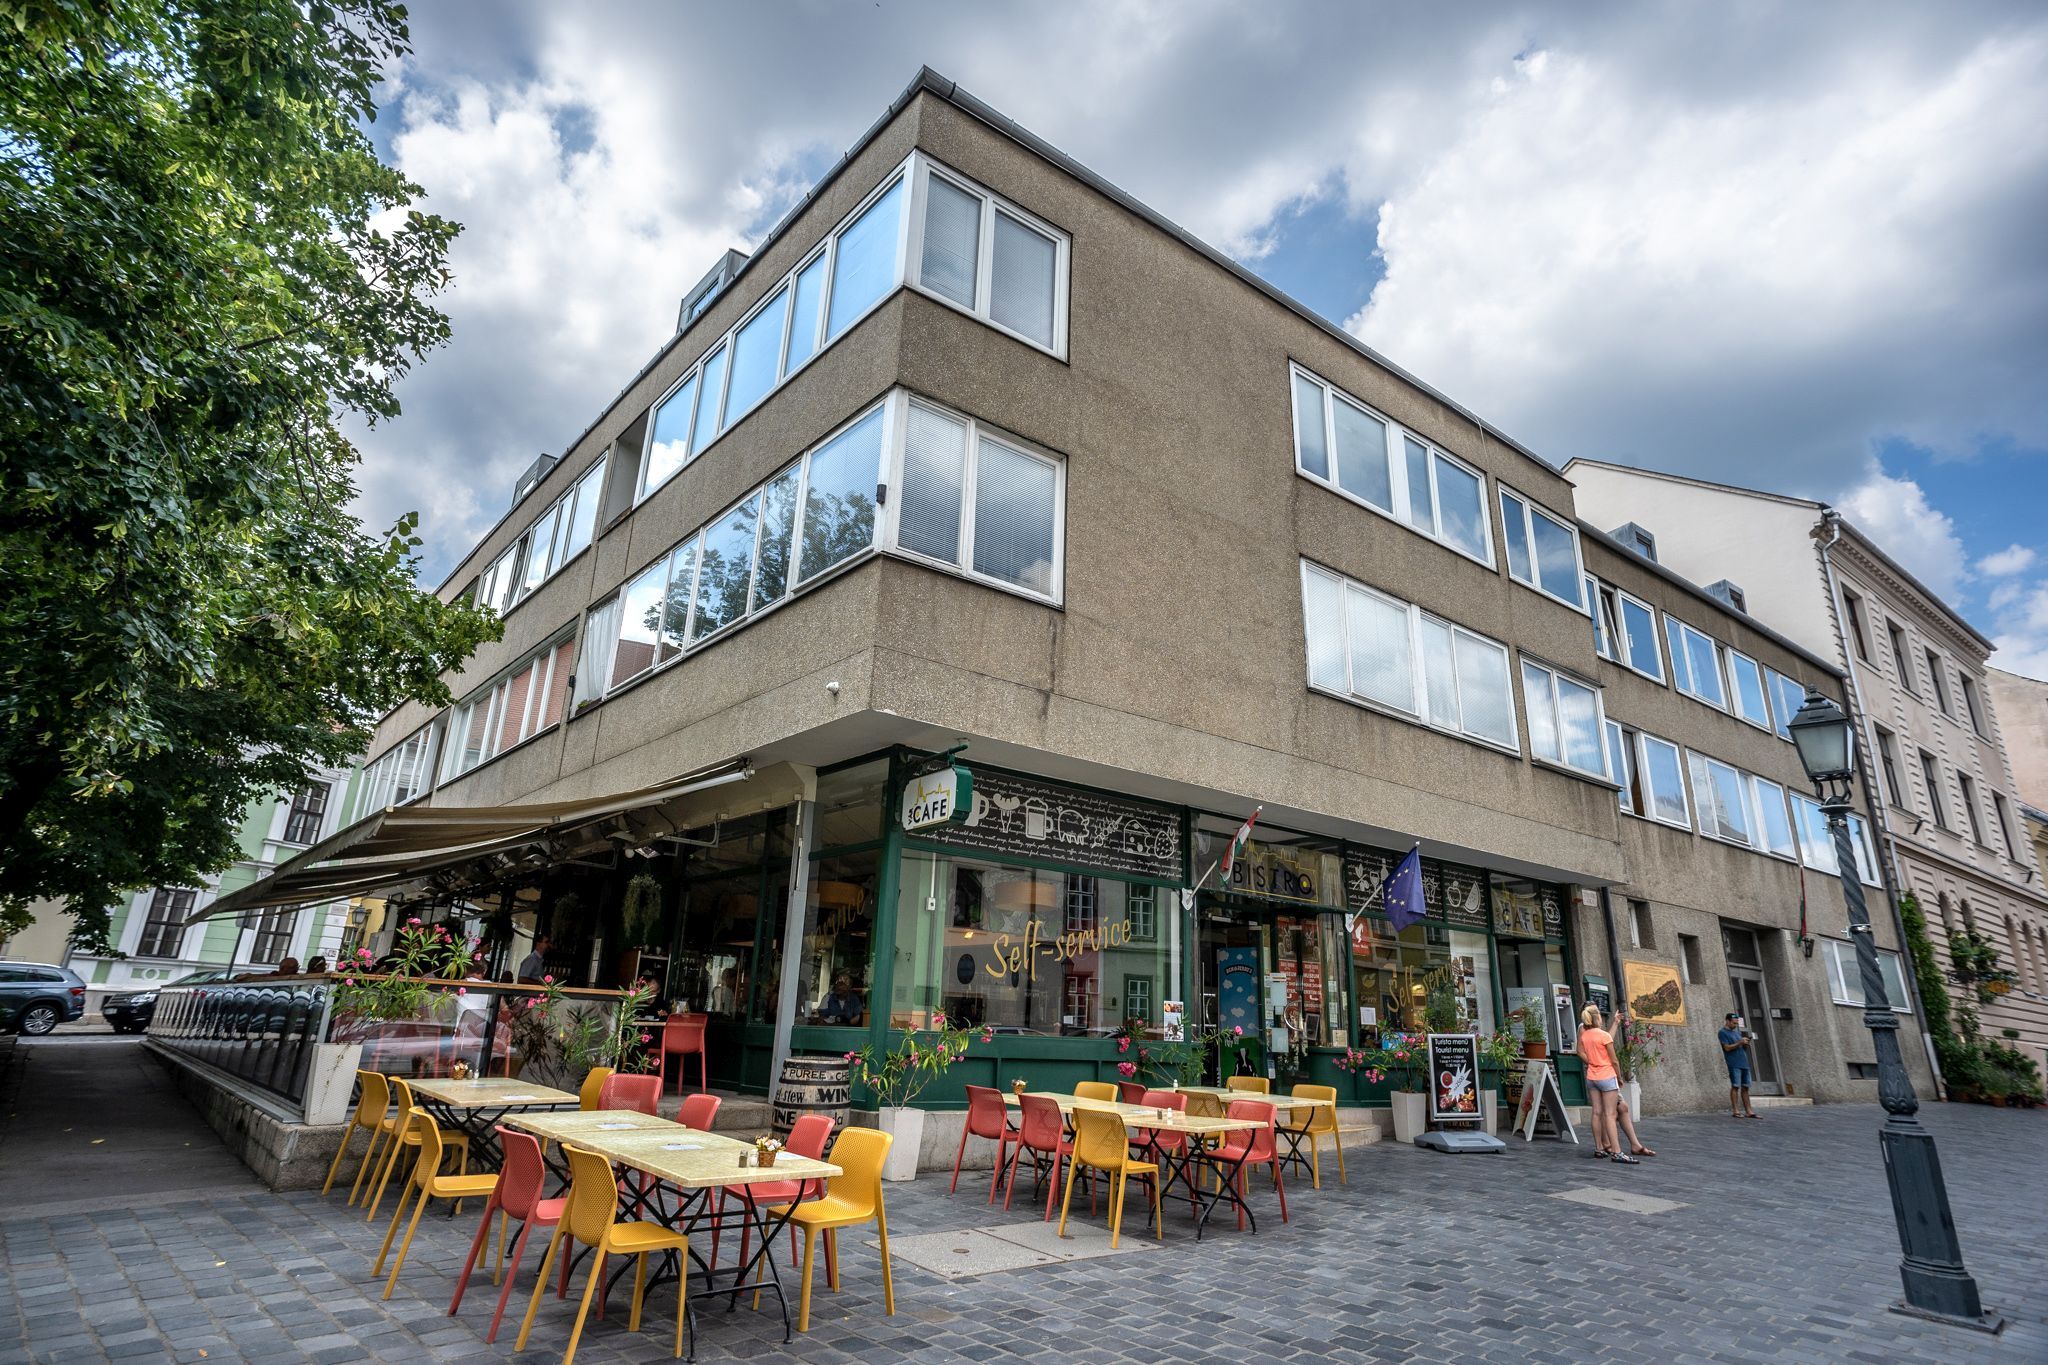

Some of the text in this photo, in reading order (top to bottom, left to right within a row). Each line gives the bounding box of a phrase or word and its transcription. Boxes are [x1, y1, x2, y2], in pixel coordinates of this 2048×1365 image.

[913, 798, 947, 823] CAFE
[1233, 862, 1312, 894] BISTRO
[986, 916, 1132, 982] Self-service
[790, 1070, 826, 1079] PUREE
